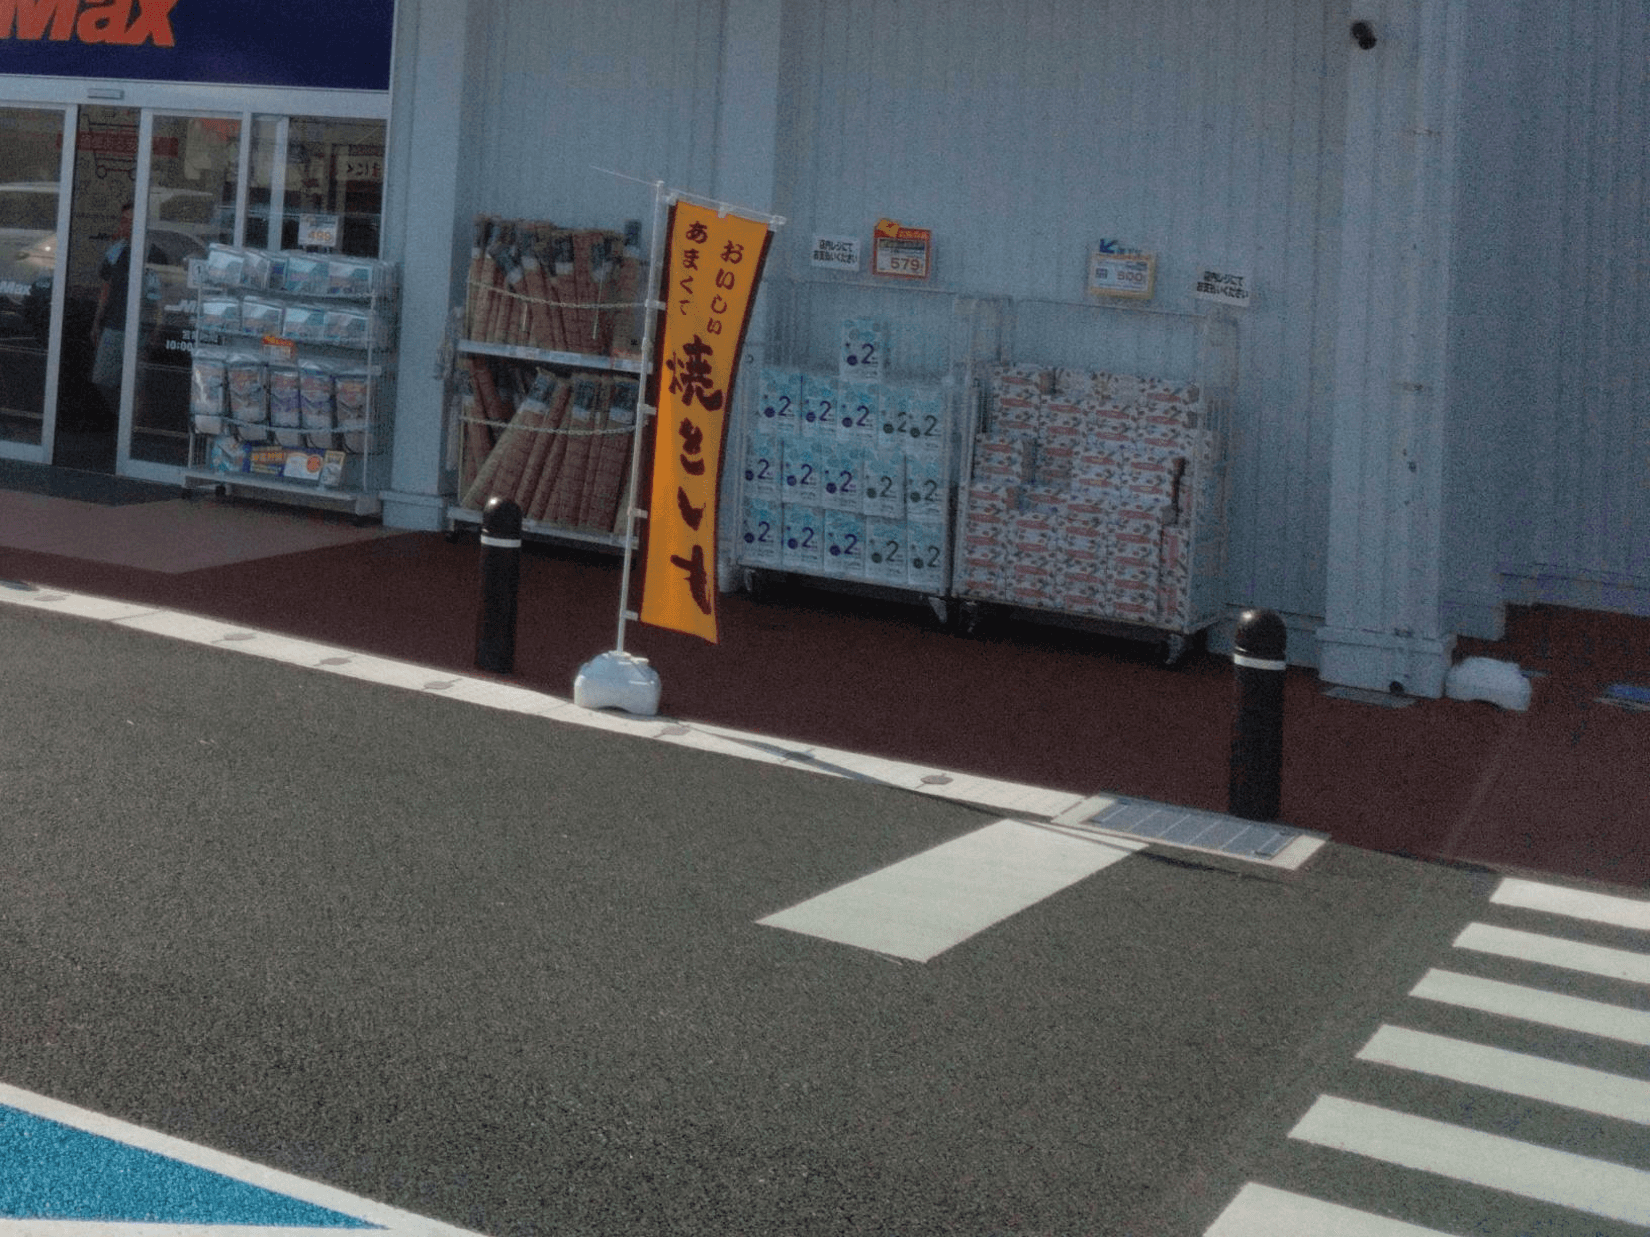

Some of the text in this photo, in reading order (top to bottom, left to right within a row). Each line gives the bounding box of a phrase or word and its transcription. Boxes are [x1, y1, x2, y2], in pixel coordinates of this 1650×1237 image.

[890, 257, 920, 270] 579
[707, 240, 744, 335] おいしい
[861, 343, 875, 364] 2
[778, 396, 791, 416] 2
[819, 400, 831, 421] 2
[856, 405, 869, 426] 2
[924, 415, 937, 436] 2
[757, 459, 769, 479] 2
[801, 464, 812, 485] 2
[840, 470, 853, 492] 2
[880, 476, 892, 497] 2
[924, 479, 937, 502] 2
[758, 521, 770, 542] 2
[801, 527, 814, 548] 2
[844, 533, 857, 555] 2
[886, 540, 899, 562] 2
[927, 545, 940, 568] 2
